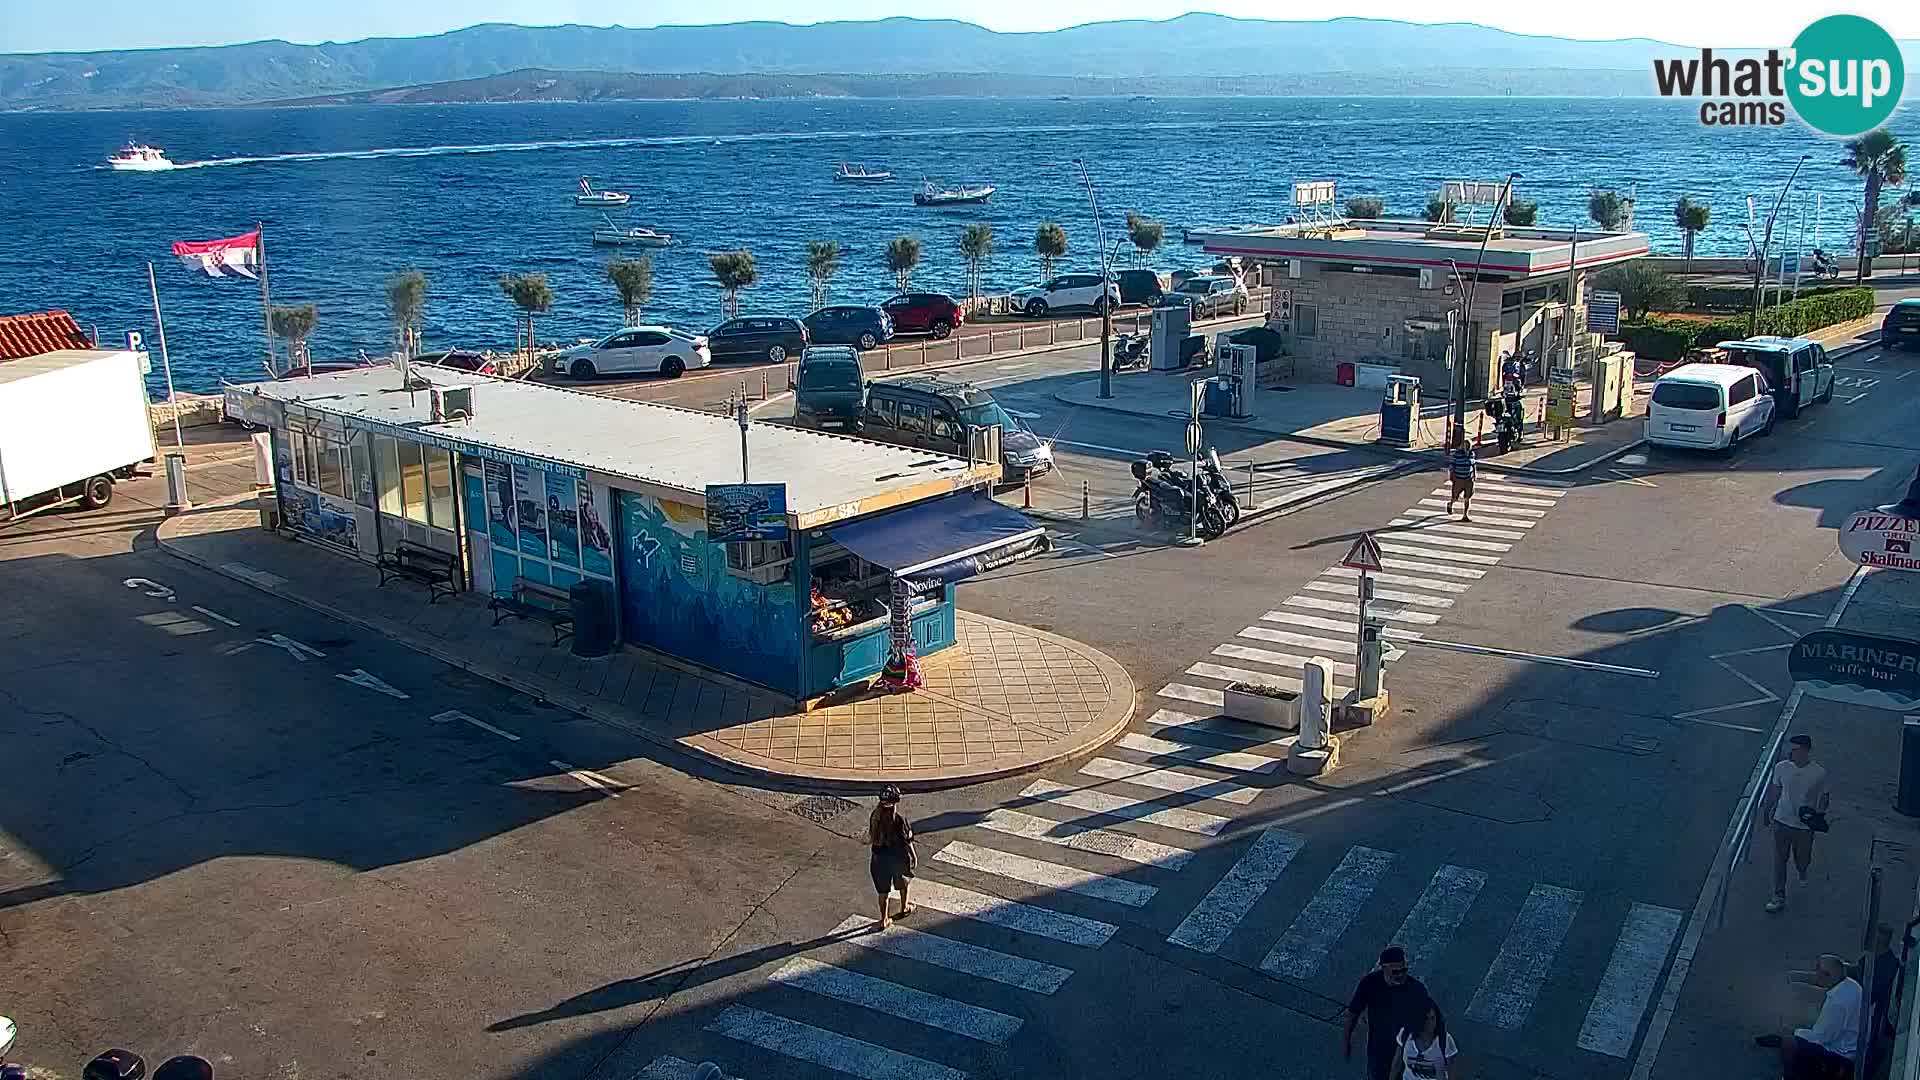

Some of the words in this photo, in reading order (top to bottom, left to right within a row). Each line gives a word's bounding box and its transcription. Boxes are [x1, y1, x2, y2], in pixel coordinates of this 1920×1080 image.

[128, 332, 142, 351] P
[479, 446, 493, 459] BUS
[494, 450, 526, 467] STATION
[529, 457, 554, 472] TICKET
[555, 464, 583, 479] OFFICE
[1848, 516, 1920, 533] PIZZE
[908, 577, 942, 596] Novine
[1801, 643, 1920, 673] MARINER
[1871, 667, 1897, 680] bar
